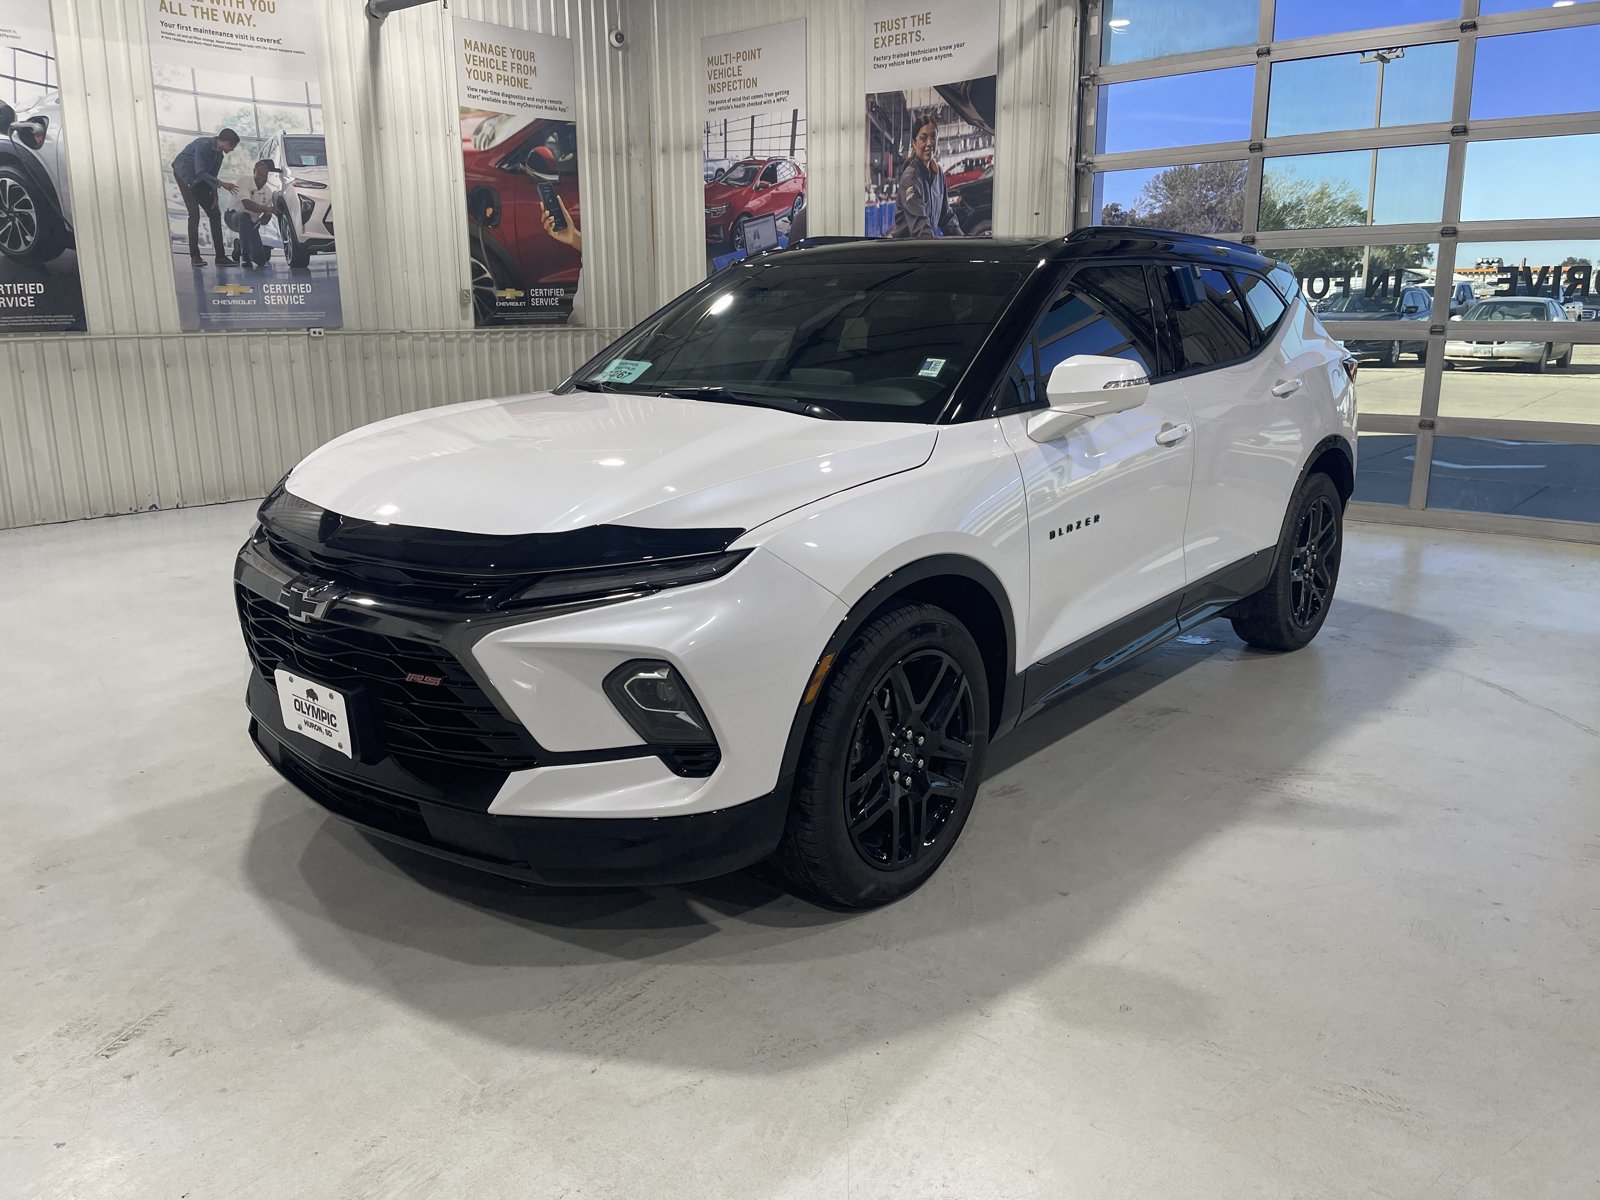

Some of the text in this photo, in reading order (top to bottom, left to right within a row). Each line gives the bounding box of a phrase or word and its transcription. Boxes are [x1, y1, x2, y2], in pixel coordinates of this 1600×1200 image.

[159, 0, 256, 27] ALL THE WAY.
[250, 0, 276, 14] YOU
[160, 20, 175, 30] Your
[177, 23, 192, 32] first
[193, 26, 234, 39] maintenance
[874, 12, 932, 34] TRUST THE
[873, 30, 925, 49] EXPERTS.
[464, 38, 536, 63] MANAGE YOUR
[707, 47, 762, 67] MULTI-POINT
[892, 51, 909, 59] trained
[910, 47, 938, 56] technicians
[939, 43, 953, 51] know
[953, 42, 966, 50] your
[464, 53, 537, 77] VEHICLE FROM
[888, 59, 905, 67] vehicle
[934, 52, 953, 61] anyone.
[466, 67, 532, 90] YOUR PHONE.
[707, 65, 742, 81] VEHICLE
[708, 77, 758, 94] INSPECTION
[467, 85, 478, 93] View
[479, 87, 500, 97] real-time
[501, 91, 526, 101] diagnostics
[536, 97, 546, 105] enjoy
[481, 95, 501, 104] available
[517, 101, 544, 110] myChevrolet
[716, 98, 727, 106] peace
[774, 89, 790, 97] getting
[717, 103, 733, 111] vehicle's
[746, 100, 762, 108] checked
[262, 283, 312, 294] CERTIFIED
[530, 288, 565, 297] CERTIFIED
[264, 295, 306, 305] SERVICE
[530, 297, 560, 306] SERVICE
[1049, 514, 1101, 540] BLAZER
[406, 673, 442, 686] RS
[293, 698, 338, 728] OLYMPIC
[303, 719, 333, 738] HURON, SD
